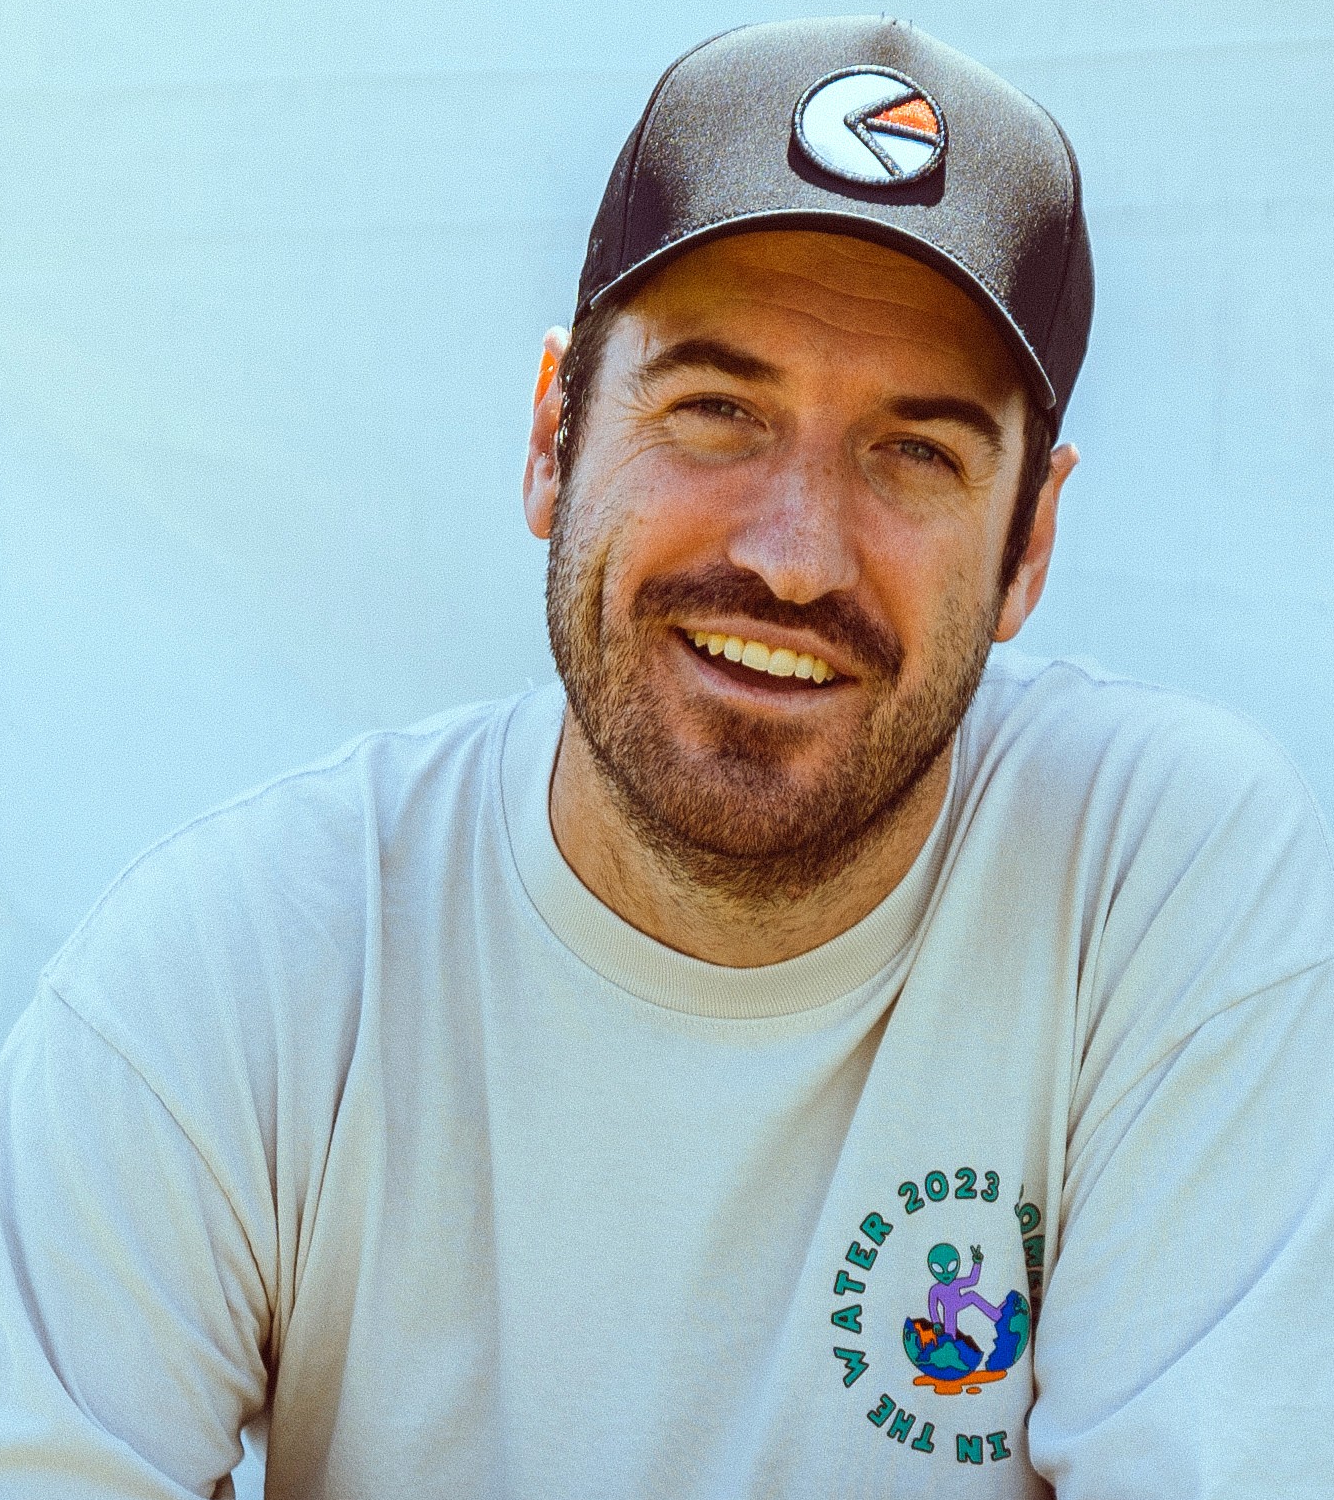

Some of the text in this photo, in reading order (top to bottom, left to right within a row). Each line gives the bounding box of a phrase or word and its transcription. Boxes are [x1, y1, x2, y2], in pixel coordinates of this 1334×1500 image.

[831, 1167, 1012, 1465] IN THE WATER 2023
